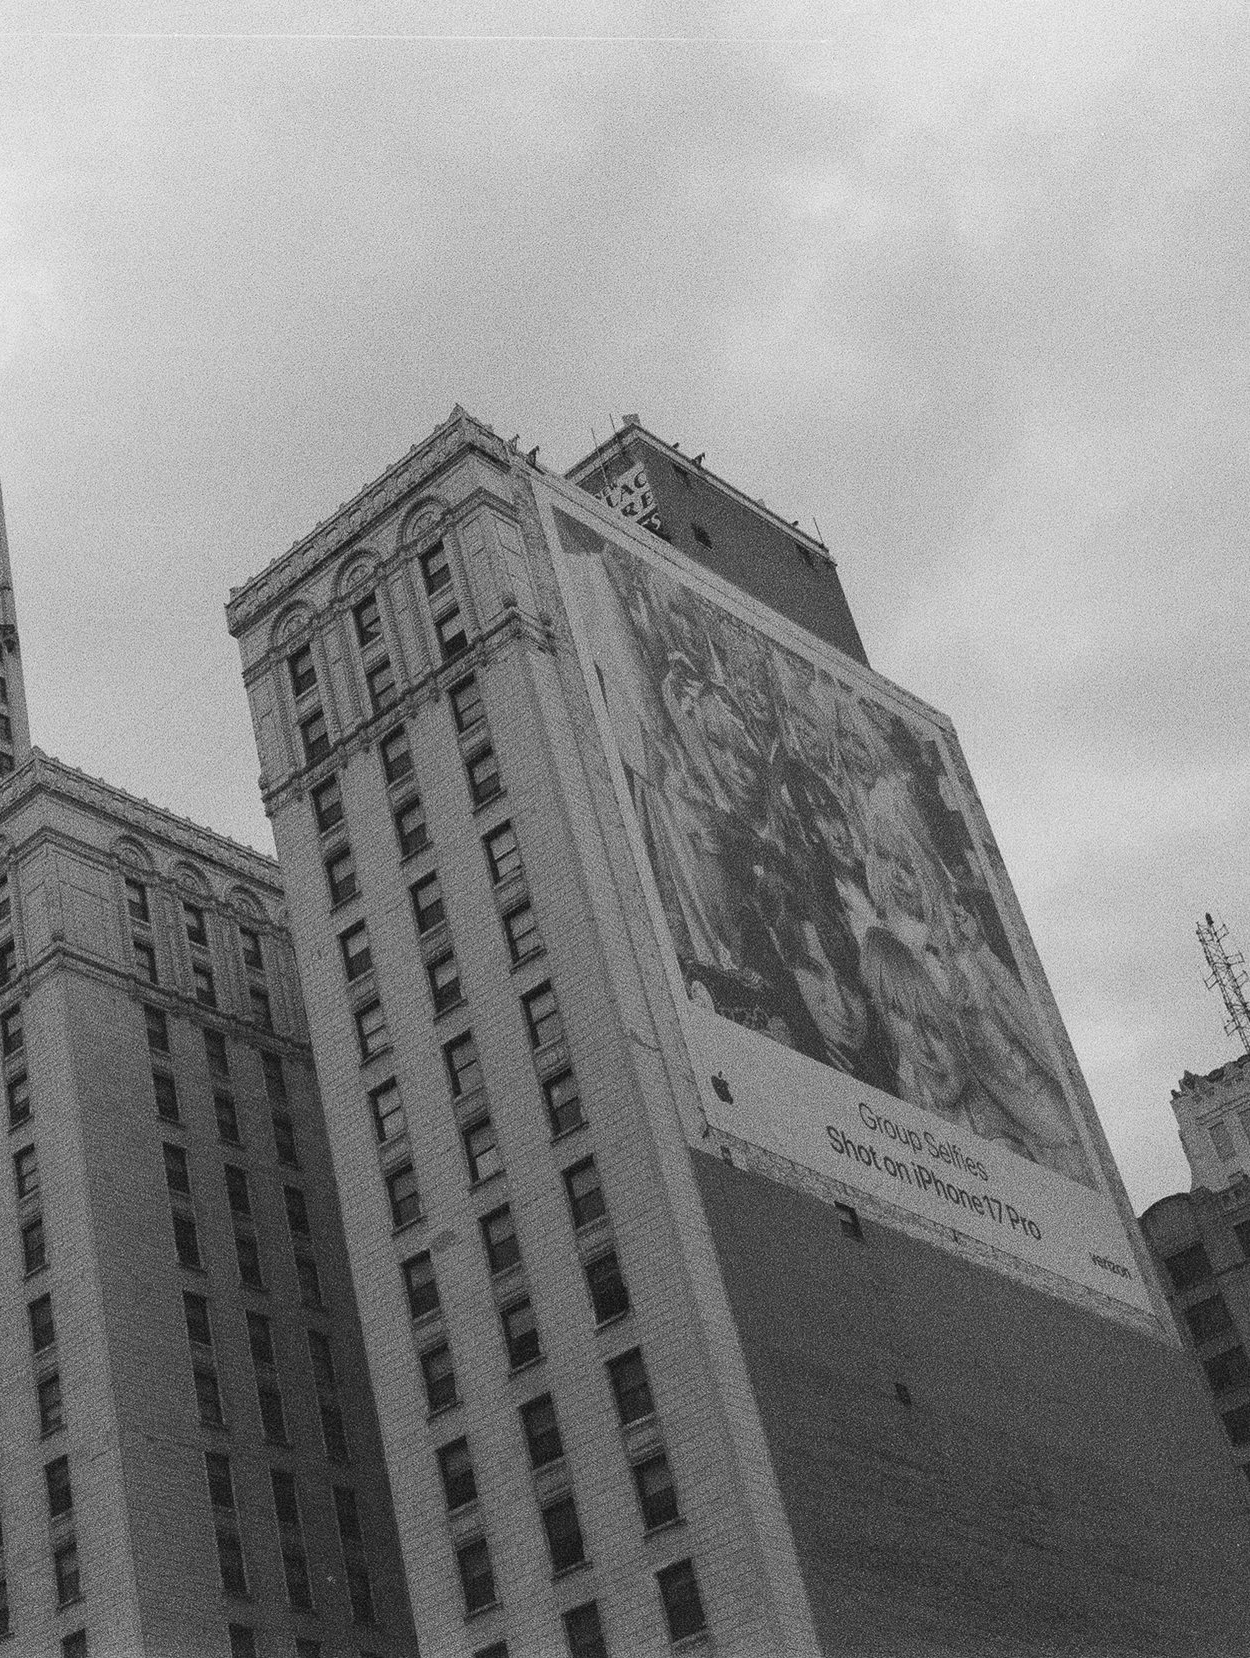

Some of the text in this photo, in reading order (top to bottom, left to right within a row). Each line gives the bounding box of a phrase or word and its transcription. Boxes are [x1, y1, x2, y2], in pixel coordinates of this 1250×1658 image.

[826, 1125, 882, 1171] Shot
[883, 1156, 913, 1184] on
[910, 1161, 985, 1215] iPhone
[1005, 1204, 1042, 1241] Pro
[858, 1102, 989, 1181] Group Selfies
